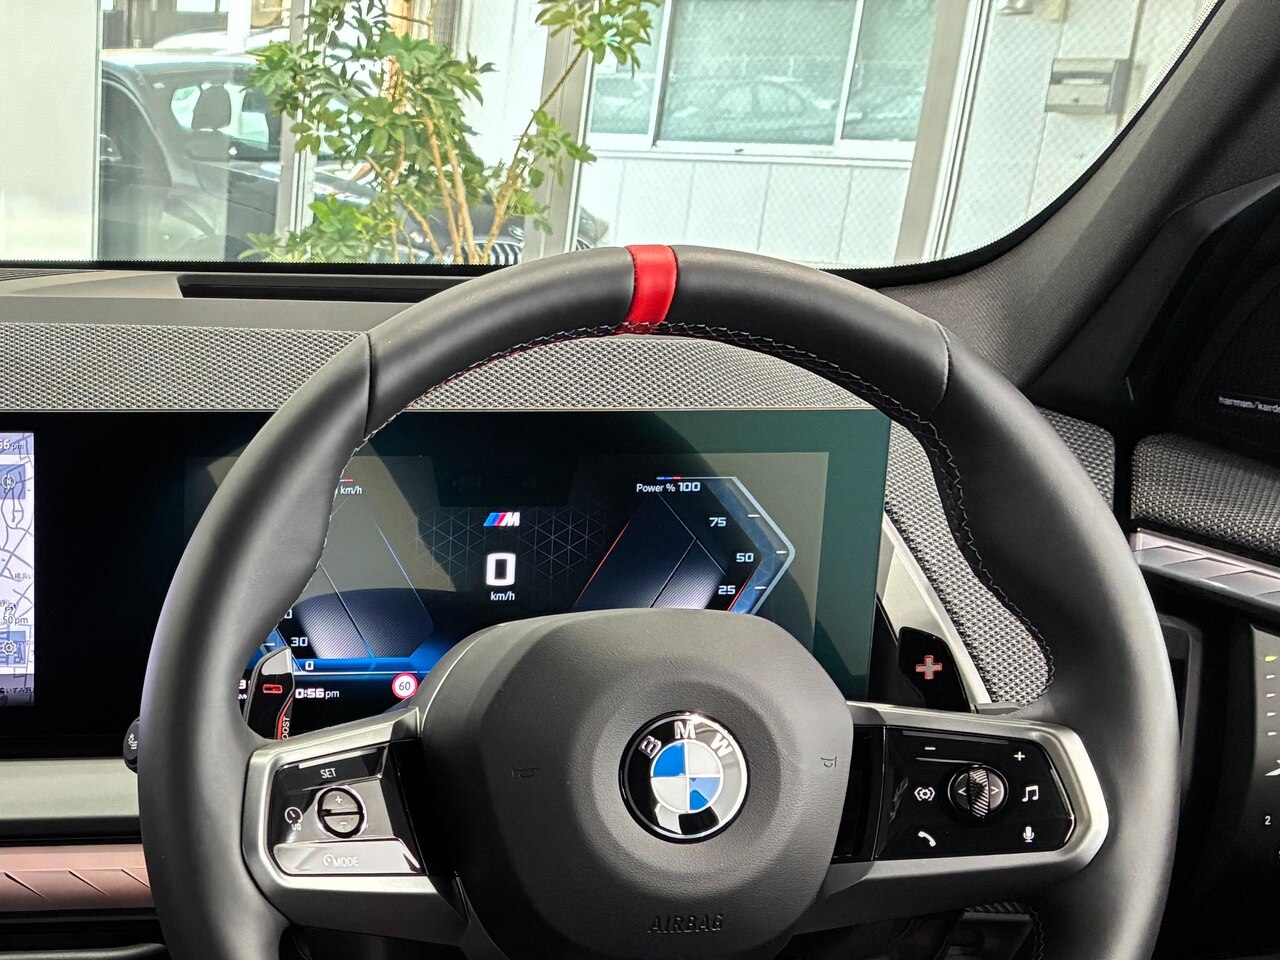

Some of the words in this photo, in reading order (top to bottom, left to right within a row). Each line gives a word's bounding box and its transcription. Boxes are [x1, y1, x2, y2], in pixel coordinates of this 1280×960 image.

[340, 485, 363, 495] km/h
[636, 483, 664, 493] Power
[665, 483, 676, 492] %
[677, 482, 701, 492] 100
[709, 517, 727, 527] 75
[736, 553, 755, 563] 50
[486, 552, 516, 587] 0
[718, 585, 736, 595] 25
[490, 591, 516, 602] km/h
[290, 637, 309, 647] 30
[305, 661, 314, 671] 0
[399, 681, 411, 691] 60
[295, 688, 325, 699] 0:56
[325, 690, 340, 701] pm
[639, 720, 734, 759] BMW
[320, 767, 337, 779] SET
[1265, 815, 1271, 826] 2
[333, 857, 359, 868] MODE
[646, 913, 724, 934] AIRBAG
